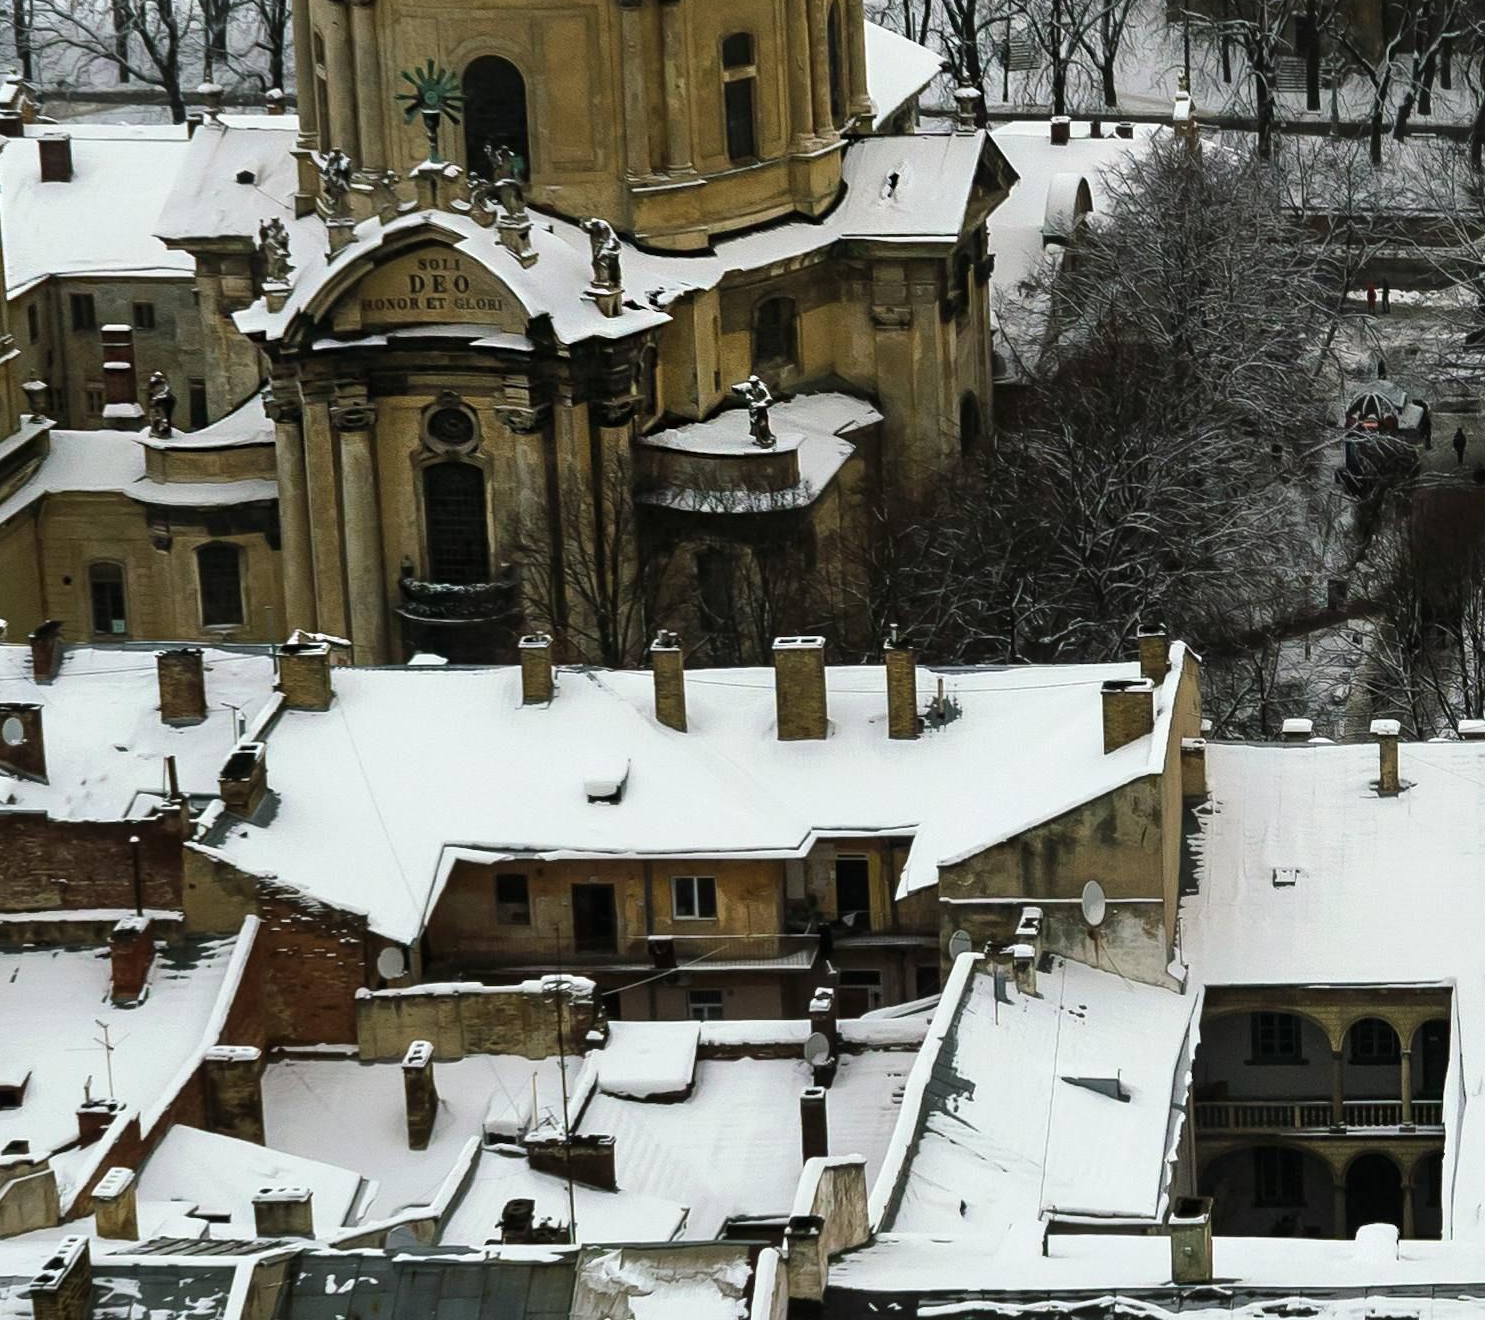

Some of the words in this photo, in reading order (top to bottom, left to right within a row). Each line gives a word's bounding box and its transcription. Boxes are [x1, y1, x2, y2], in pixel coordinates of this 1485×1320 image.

[418, 258, 461, 271] SOLI
[408, 274, 470, 294] DEO
[361, 297, 420, 311] HONOR
[426, 297, 447, 310] ET
